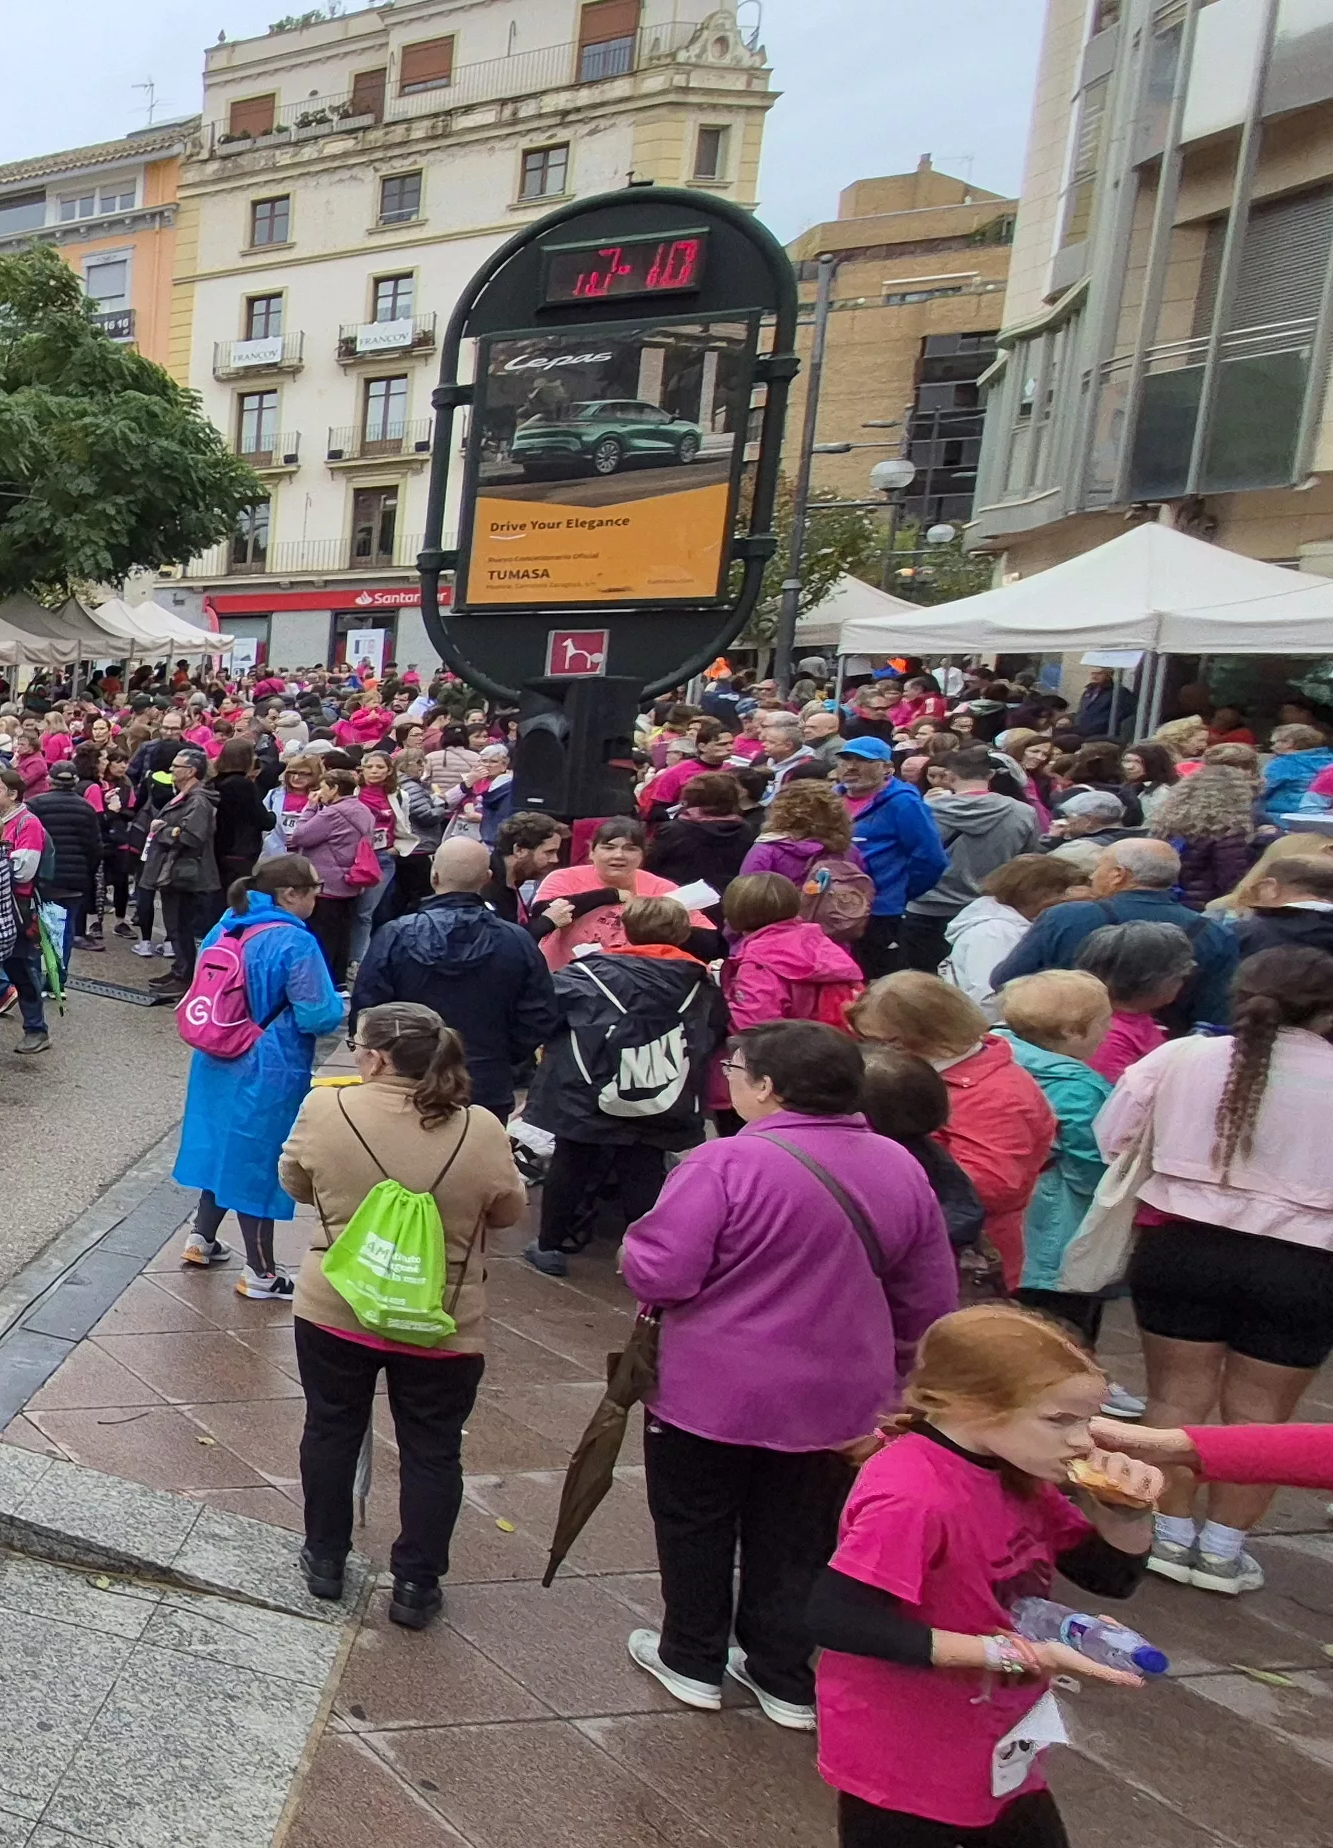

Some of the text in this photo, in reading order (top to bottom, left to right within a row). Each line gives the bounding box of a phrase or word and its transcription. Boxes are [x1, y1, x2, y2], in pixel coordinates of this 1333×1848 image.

[490, 516, 630, 532] Drive Your Elegance
[488, 568, 550, 580] TUMASA
